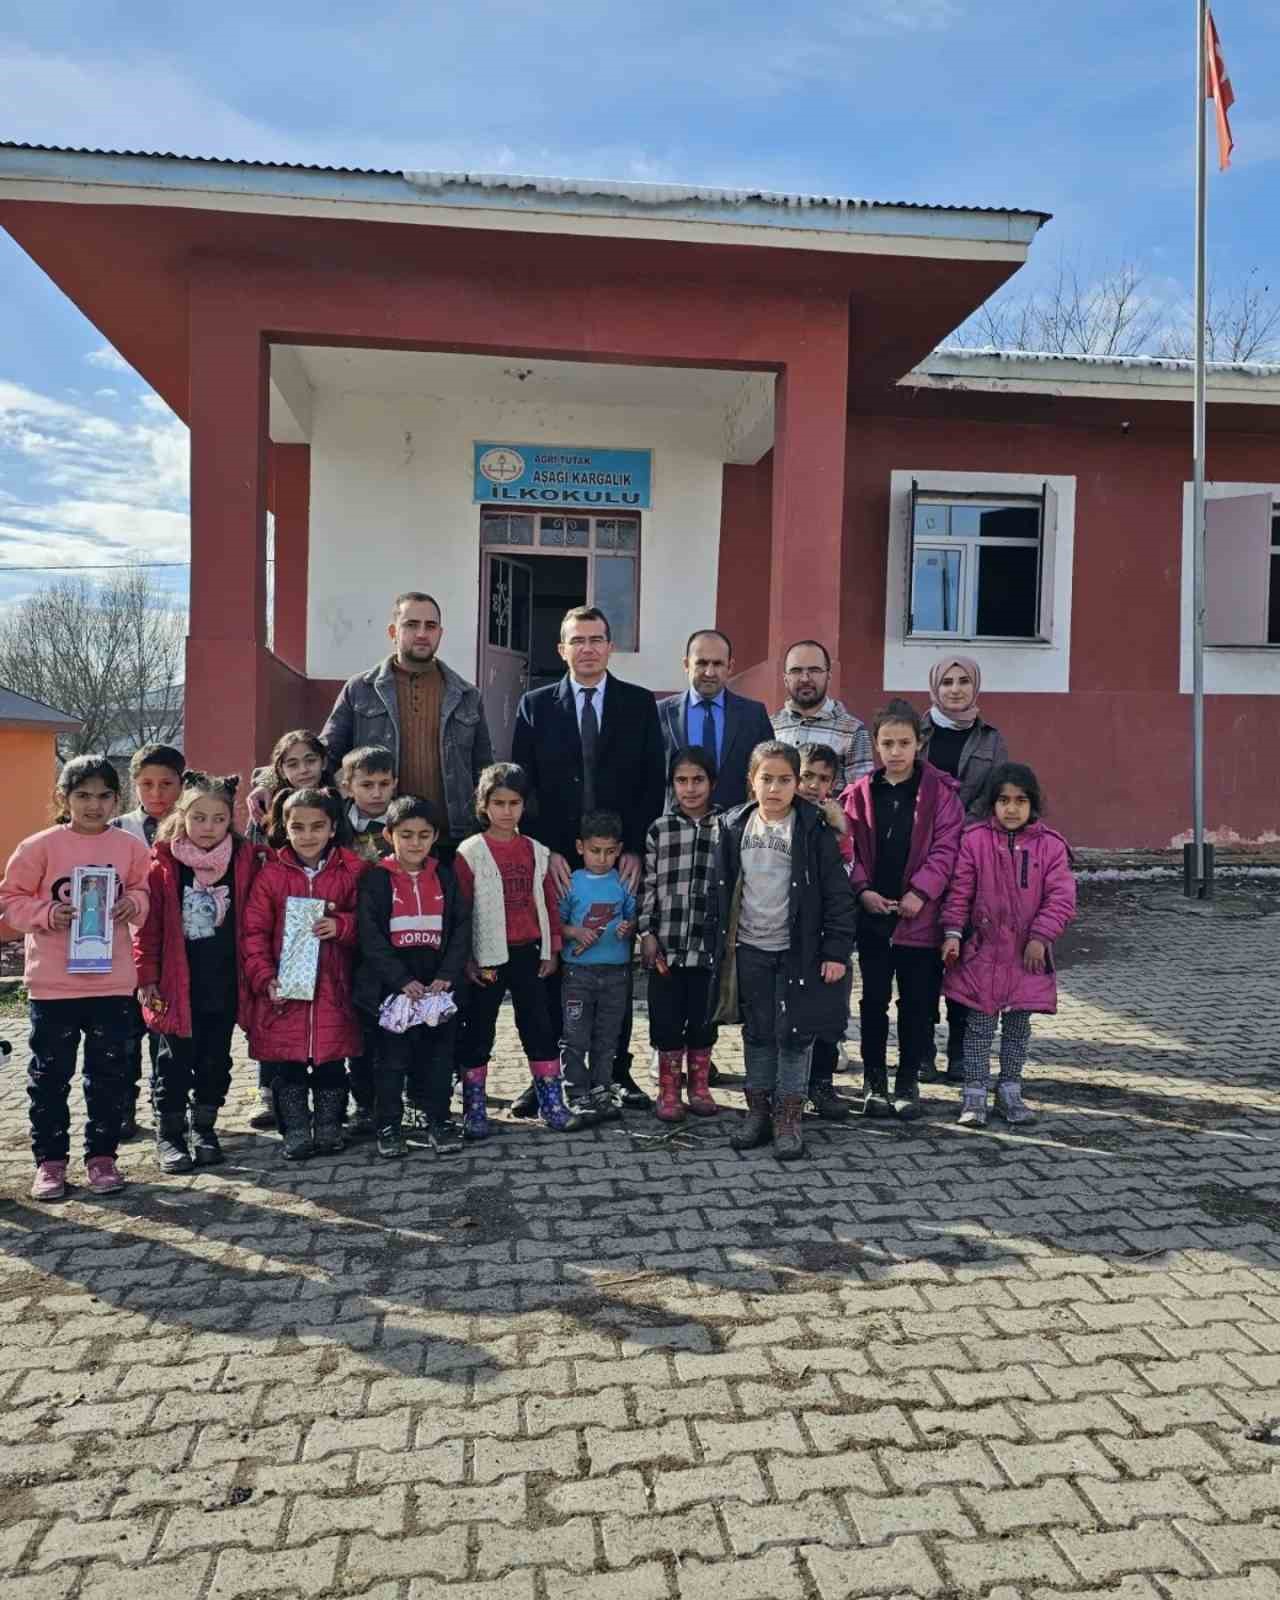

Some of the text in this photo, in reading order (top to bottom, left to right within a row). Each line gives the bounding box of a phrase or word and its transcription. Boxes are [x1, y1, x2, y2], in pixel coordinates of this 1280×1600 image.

[560, 456, 591, 465] TUTAK
[572, 471, 632, 486] KARGALIK
[491, 483, 641, 504] İLKOKULU
